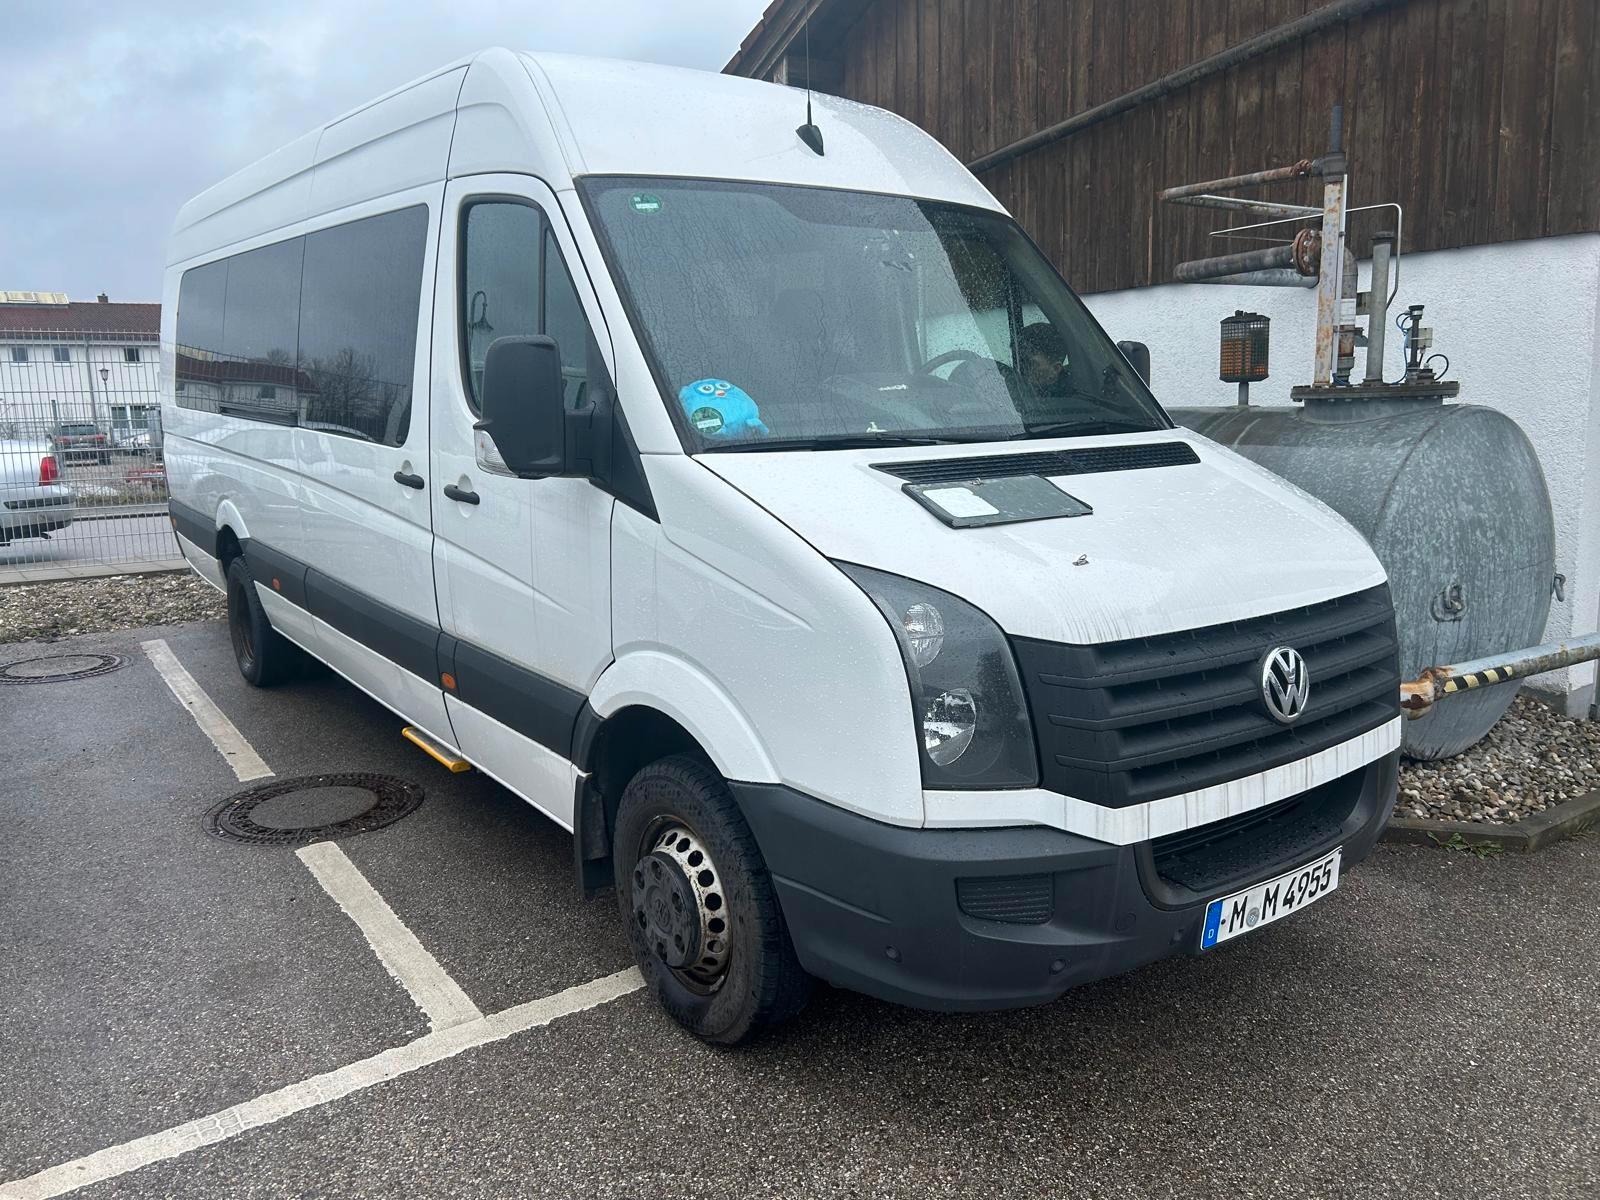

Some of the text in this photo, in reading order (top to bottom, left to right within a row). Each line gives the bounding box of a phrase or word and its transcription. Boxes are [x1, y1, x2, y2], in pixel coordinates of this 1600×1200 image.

[1263, 646, 1310, 723] VW
[1228, 857, 1335, 933] M M 4955
[1208, 928, 1215, 939] D
